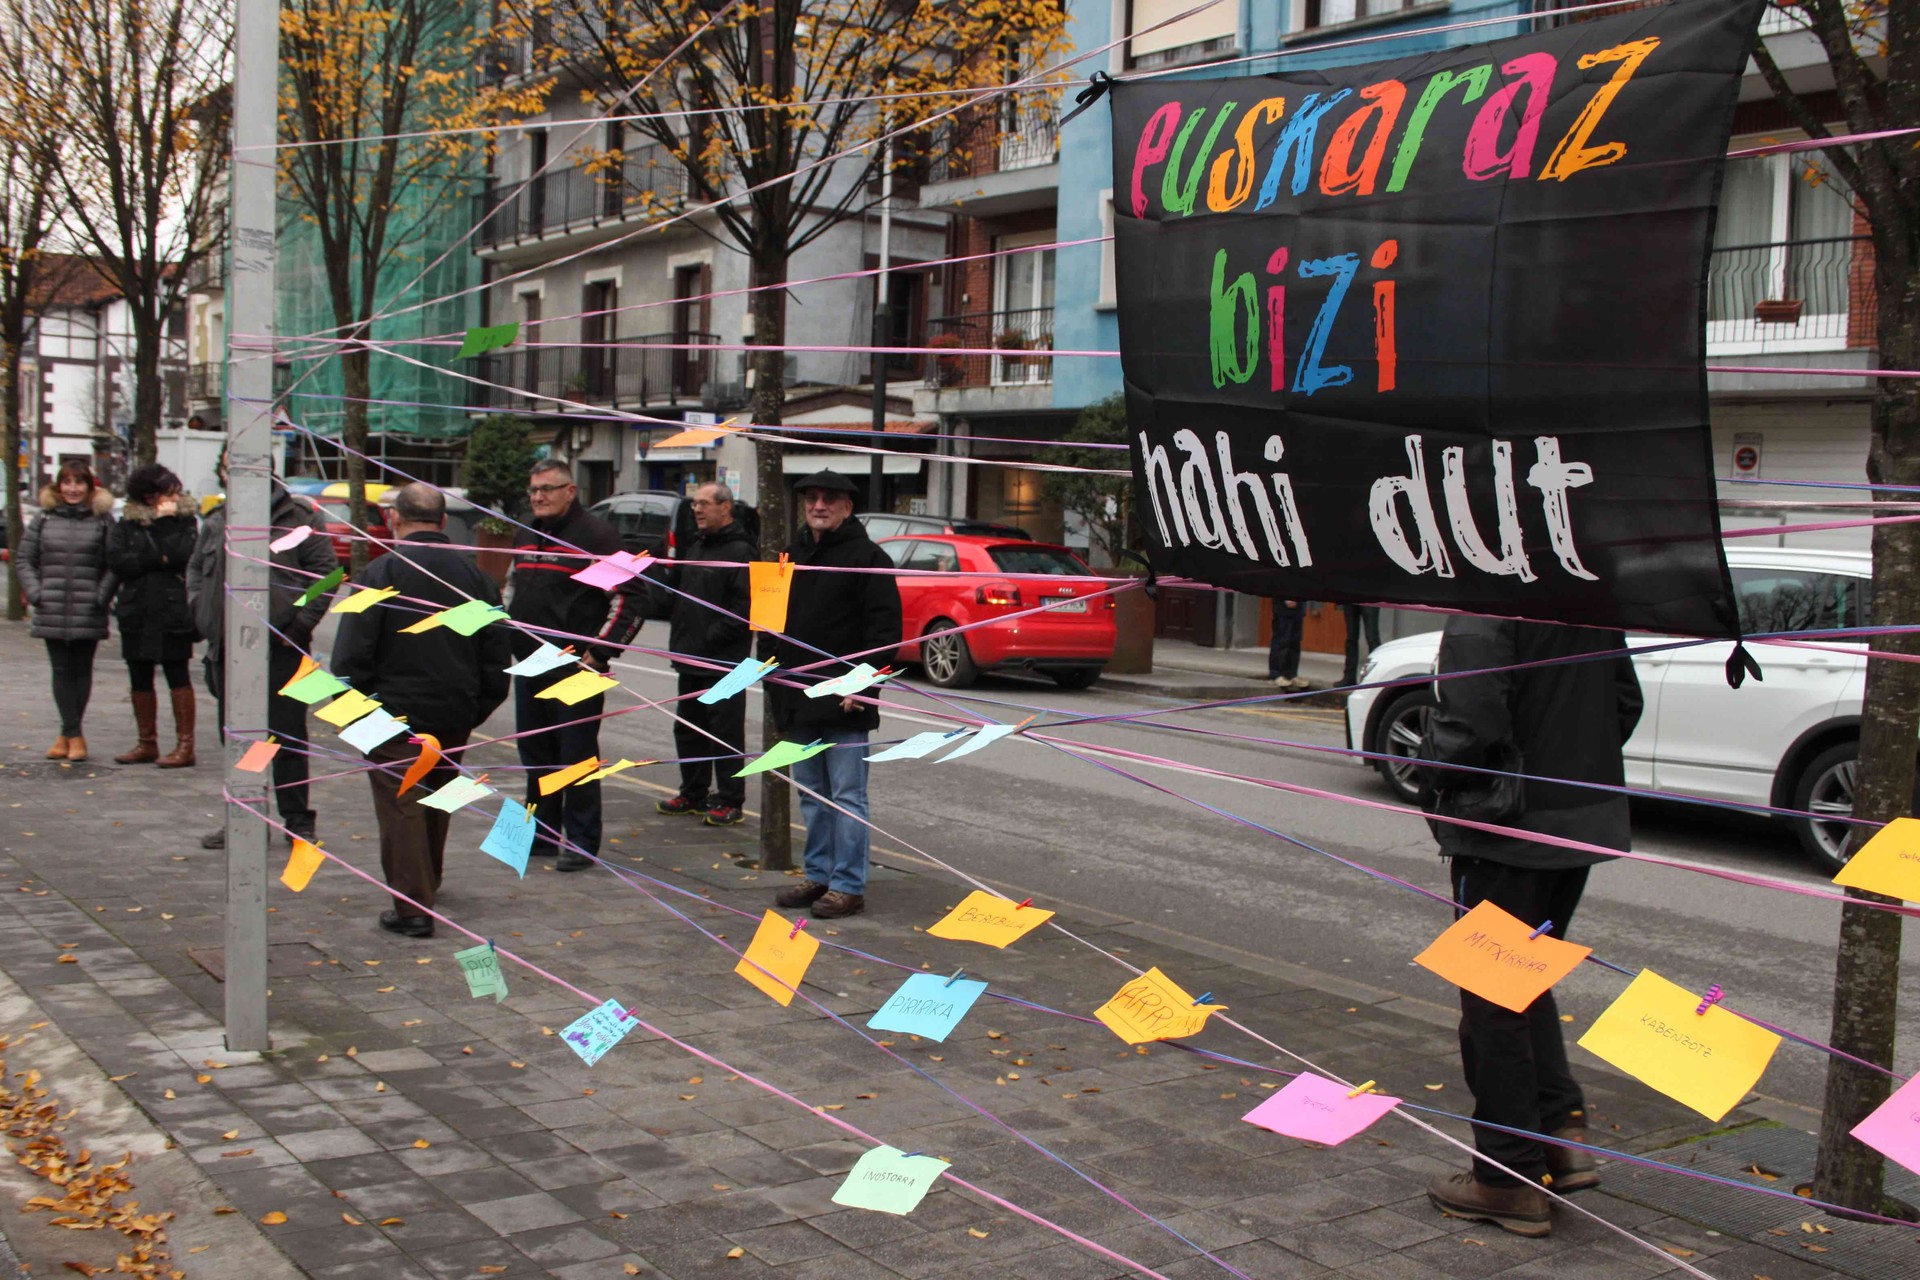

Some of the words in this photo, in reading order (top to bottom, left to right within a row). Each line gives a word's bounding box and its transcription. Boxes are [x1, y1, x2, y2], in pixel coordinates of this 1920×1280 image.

[1131, 36, 1663, 220] euskaraz
[1209, 239, 1399, 396] bizi
[1139, 429, 1314, 569] nahi
[1369, 434, 1600, 583] dut
